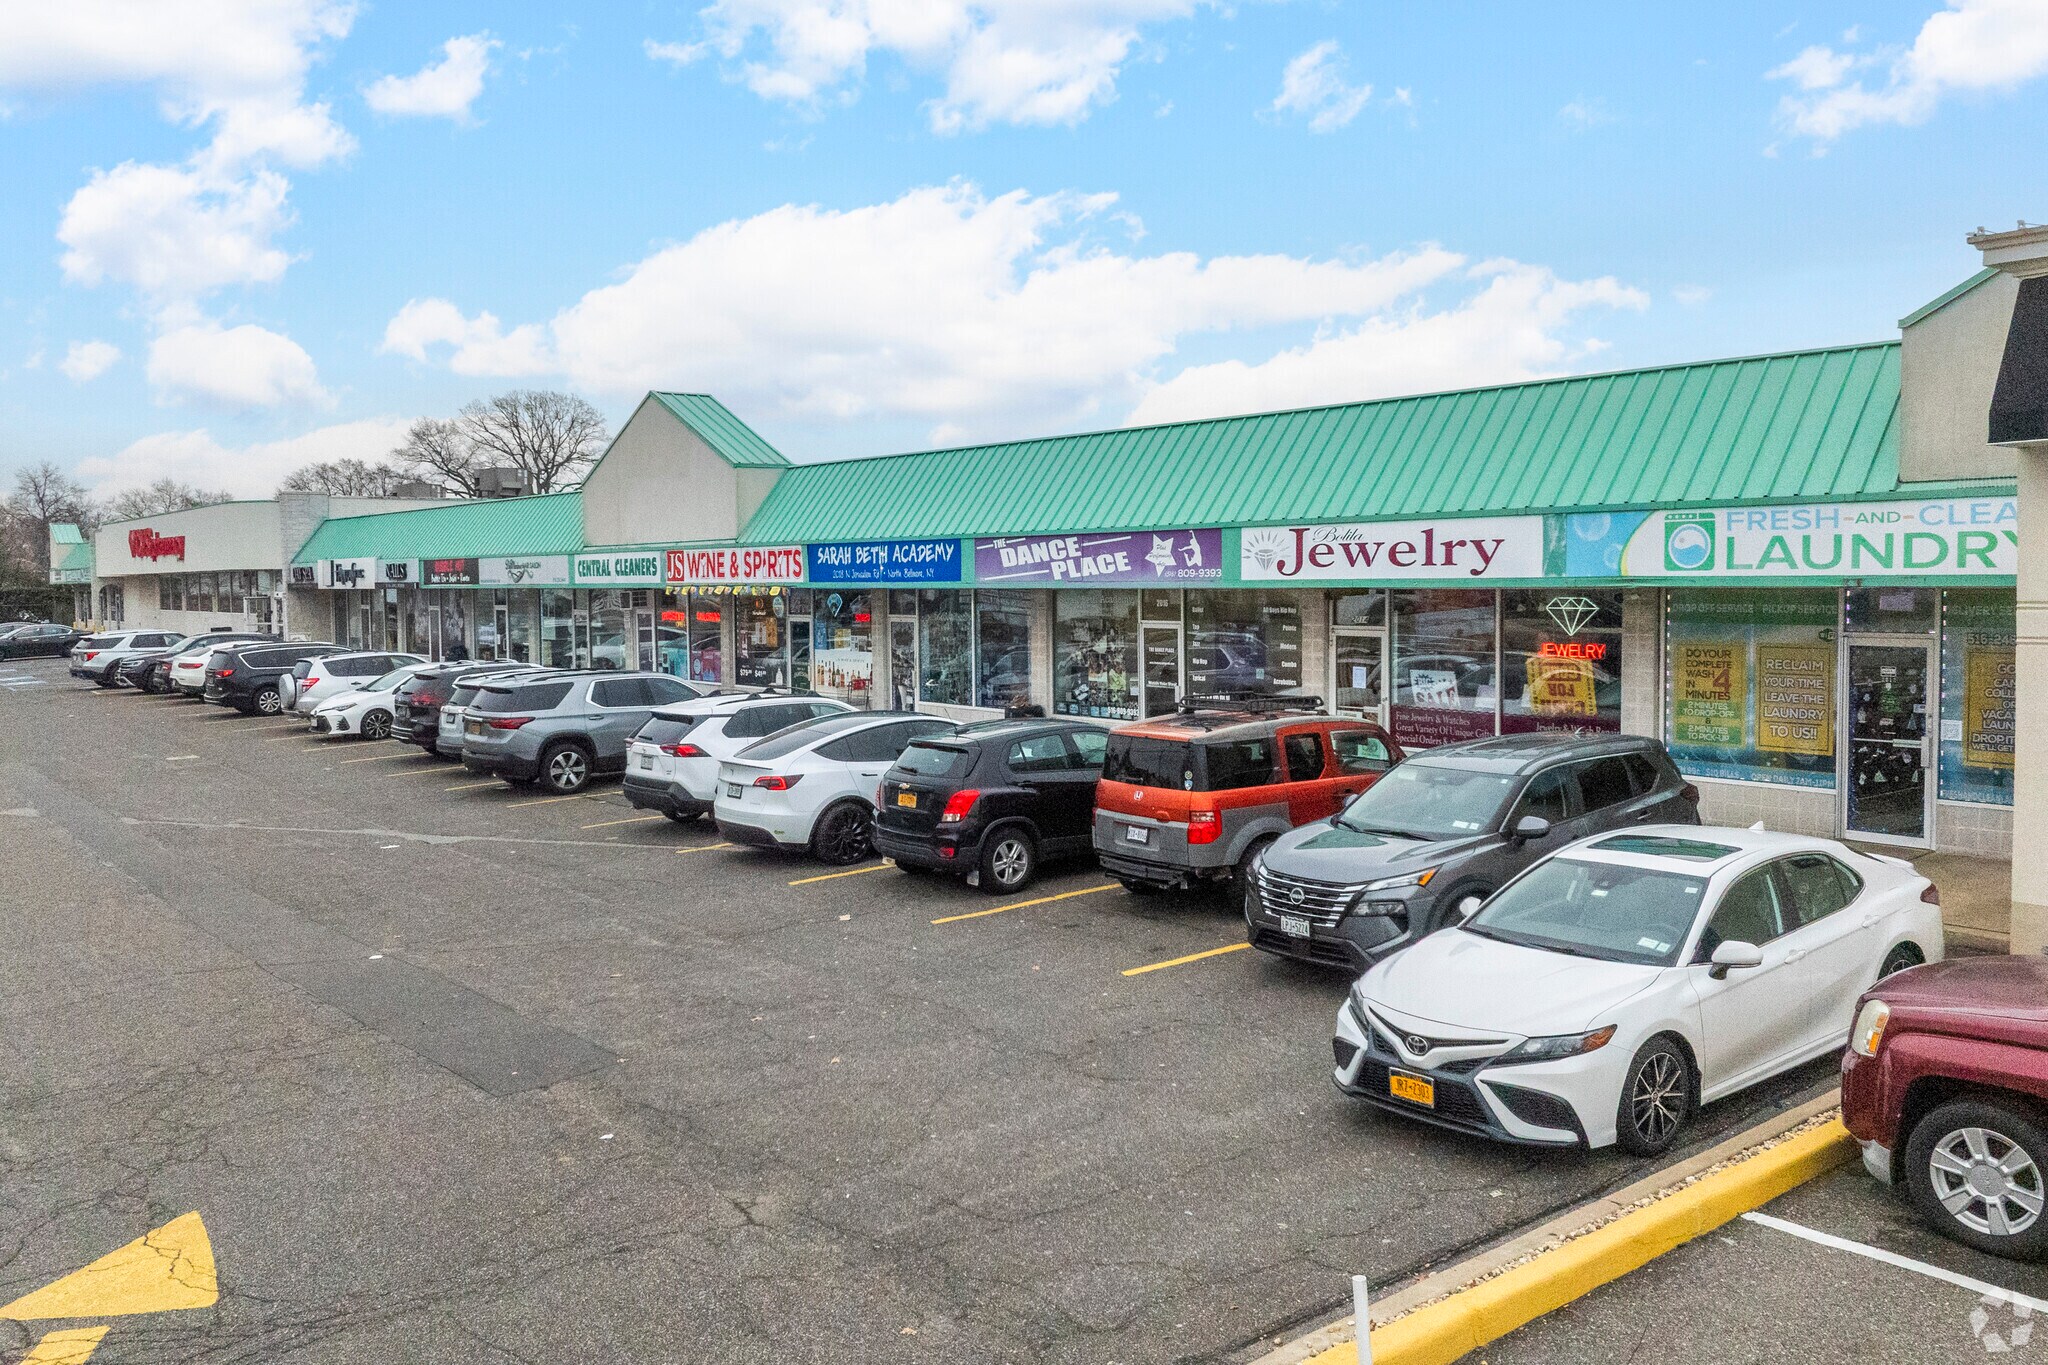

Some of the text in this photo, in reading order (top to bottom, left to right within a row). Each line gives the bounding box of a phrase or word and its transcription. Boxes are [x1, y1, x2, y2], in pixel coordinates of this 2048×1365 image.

[1313, 526, 1363, 543] Bolila
[993, 538, 1006, 549] THE
[817, 543, 954, 566] SARAH BETH ACADEMY
[999, 537, 1082, 568] DANCE
[1276, 527, 1505, 576] Jewelry
[578, 556, 658, 578] CENTRAL CLEANERS
[668, 549, 802, 580] JS WINE & SPIRITS
[1050, 551, 1132, 580] PLACE
[1178, 569, 1222, 578] 809-9393
[1538, 642, 1606, 660] JEWELRY
[1686, 649, 1732, 659] DO YOUR
[1685, 660, 1732, 669] COMPLETE
[1766, 659, 1823, 671] RECLAIM
[1686, 669, 1714, 679] WASH
[1686, 680, 1695, 689] IN
[1713, 668, 1731, 694] 4
[1764, 677, 1795, 689] YOUR
[1685, 690, 1731, 701] MINUTES
[1765, 692, 1824, 704] LEAVE THE
[1688, 702, 1728, 711] 2 MINUTES
[1396, 711, 1470, 726] Fine Jewelry & Watches
[1684, 708, 1735, 718] TO DROP-OFF
[1764, 707, 1825, 721] LAUNDRY
[1396, 722, 1414, 732] Great
[1415, 724, 1438, 735] Variety
[1439, 725, 1448, 735] Of
[1448, 727, 1474, 738] Unique
[1688, 726, 1728, 735] 2 MINUTES
[1770, 725, 1817, 739] TO US!!
[1396, 734, 1418, 744] Special
[1419, 735, 1442, 745] Orders
[1687, 733, 1730, 742] TO PICK-UP
[1751, 772, 1772, 782] OPEN
